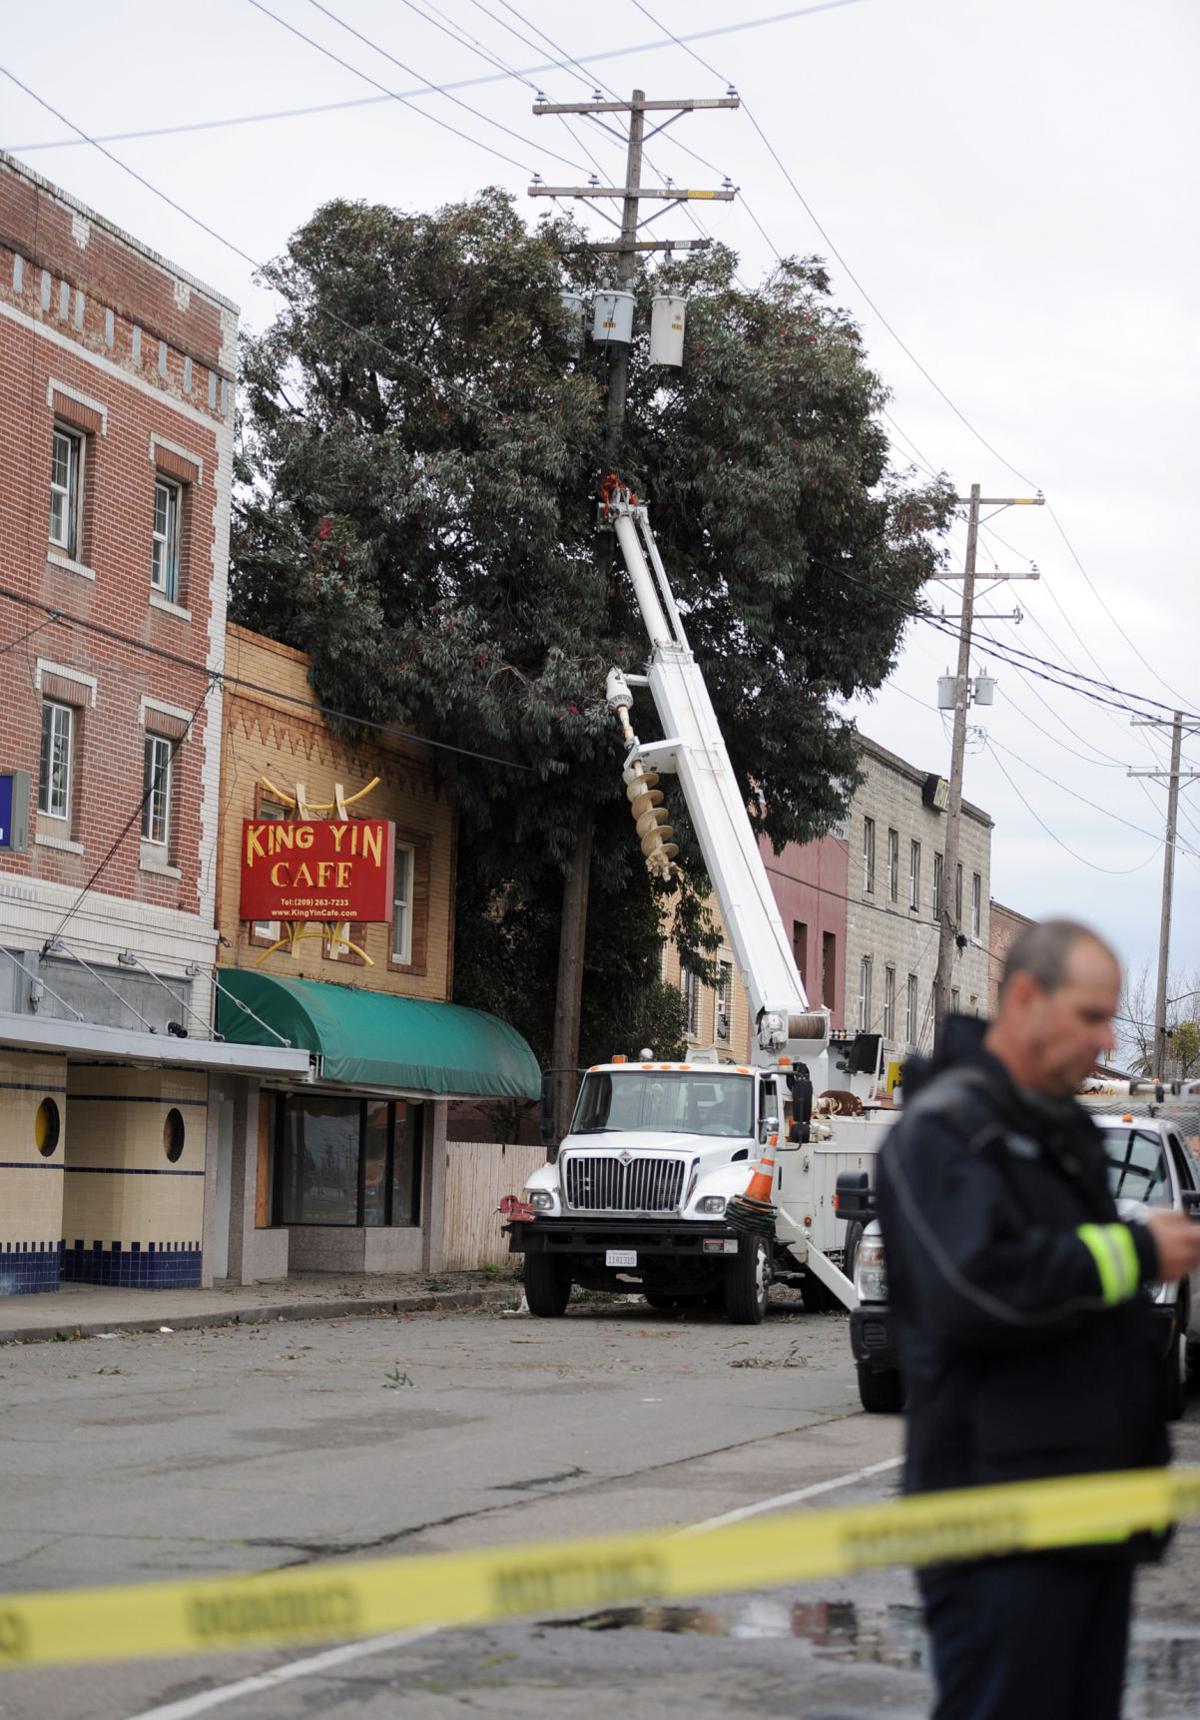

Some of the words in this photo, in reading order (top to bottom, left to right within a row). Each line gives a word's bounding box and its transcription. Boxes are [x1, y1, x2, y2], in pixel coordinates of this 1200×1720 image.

[247, 825, 314, 867] KING
[329, 825, 383, 867] YIN
[270, 862, 353, 888] CAFE
[271, 909, 357, 918] www.KingYinCafe.com
